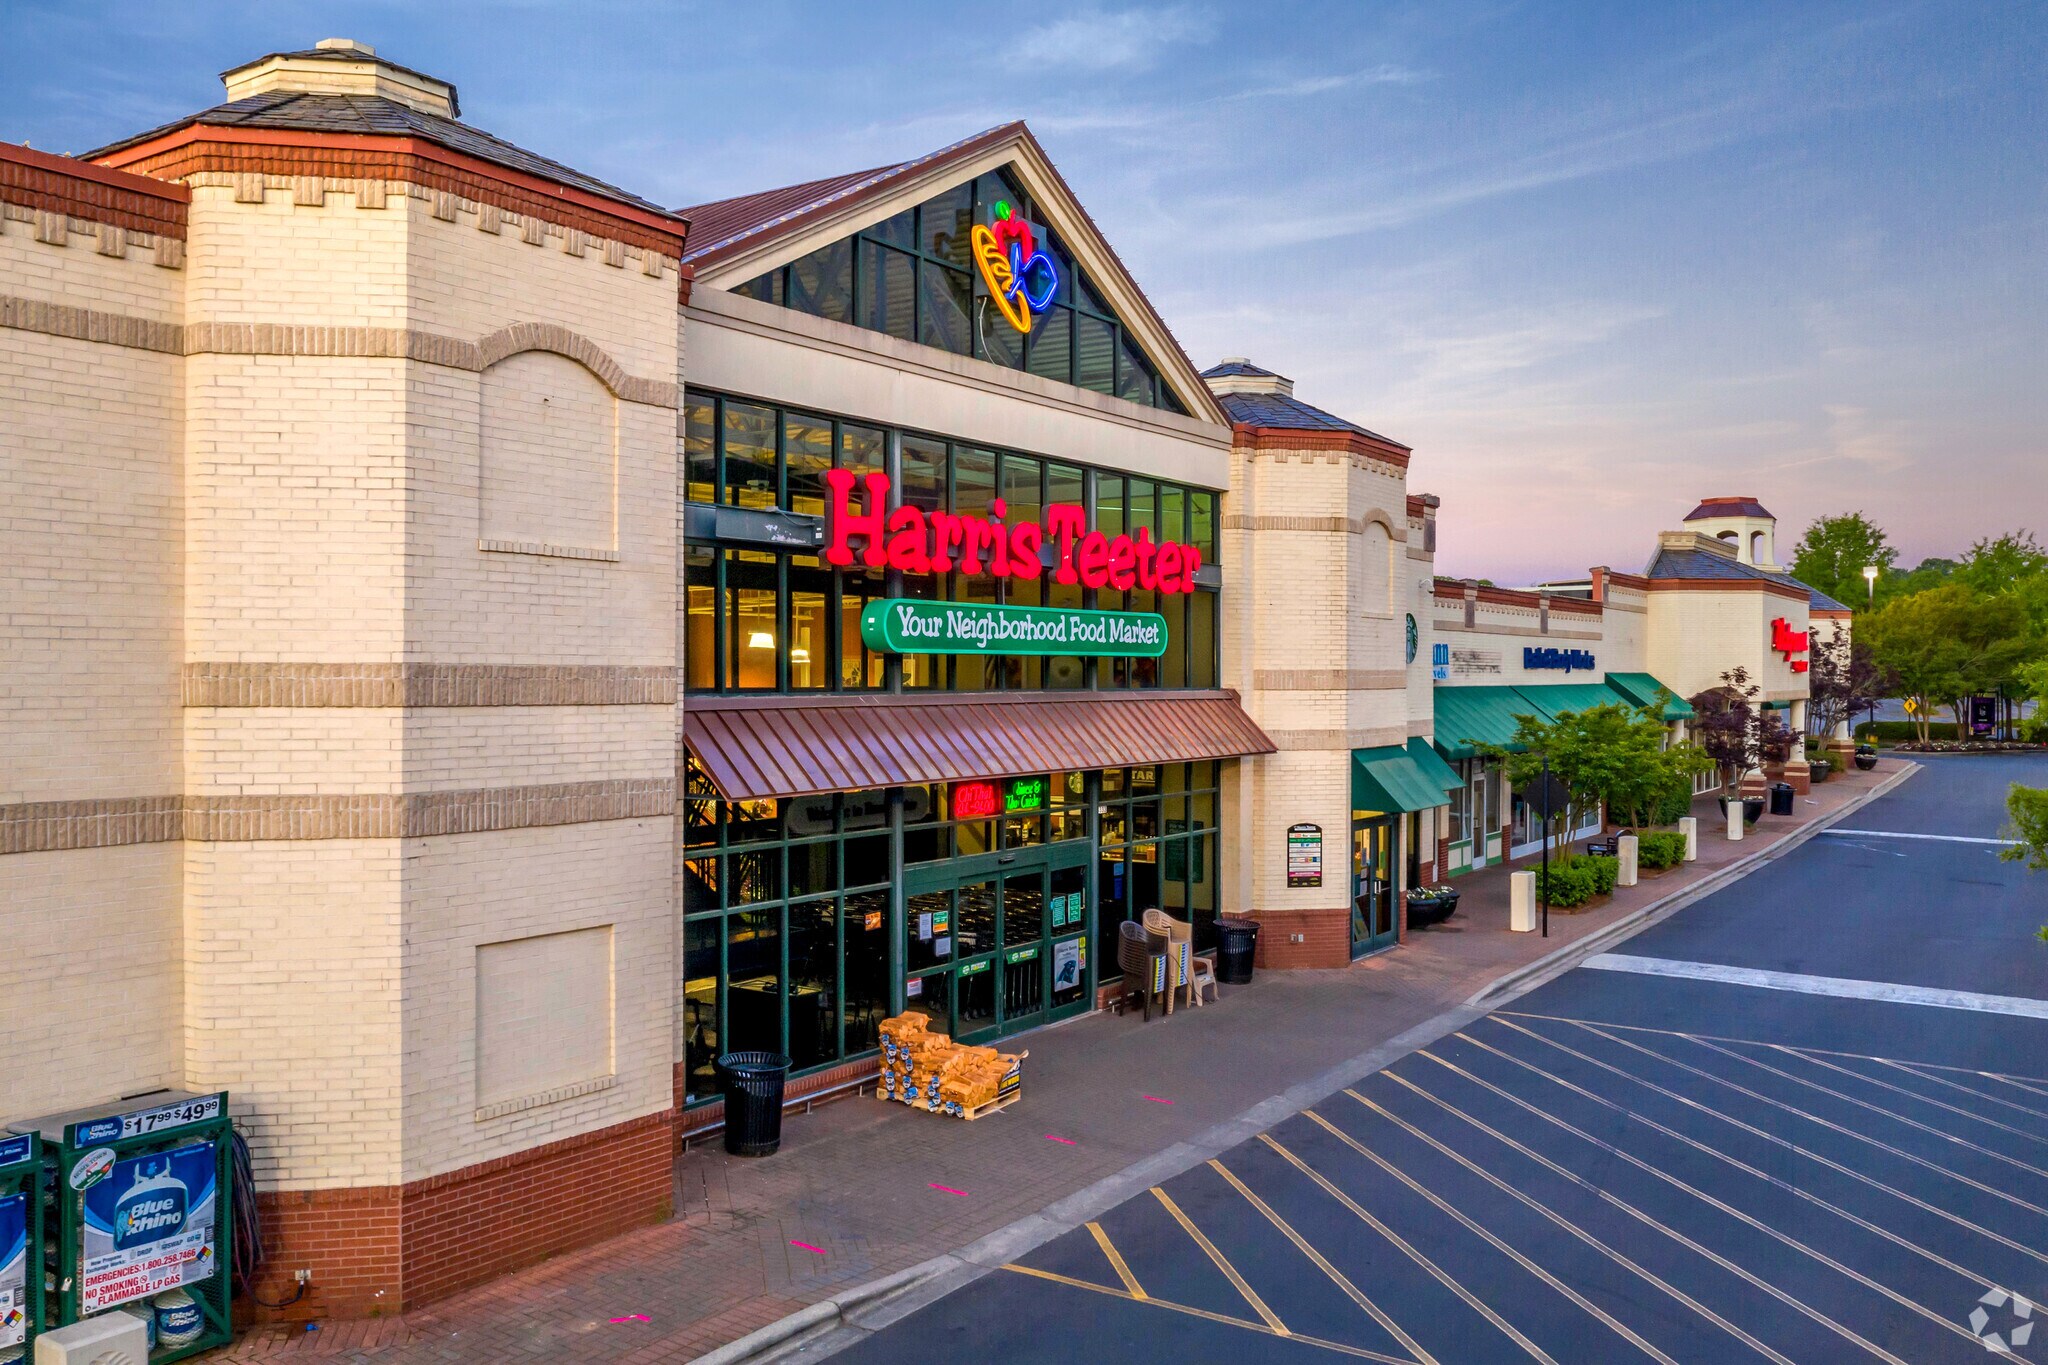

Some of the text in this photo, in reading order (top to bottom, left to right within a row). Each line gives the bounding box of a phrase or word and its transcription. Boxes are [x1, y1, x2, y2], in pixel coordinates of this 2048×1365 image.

[824, 468, 1201, 594] Harris Teeter
[897, 605, 1160, 648] Your Neighborhood Food Market
[91, 1123, 114, 1133] Blue
[130, 1198, 174, 1219] Blue
[126, 1211, 182, 1237] Rhino
[85, 1277, 139, 1300] NO SMOKING
[98, 1274, 181, 1306] FLAMMABLE LP GAS
